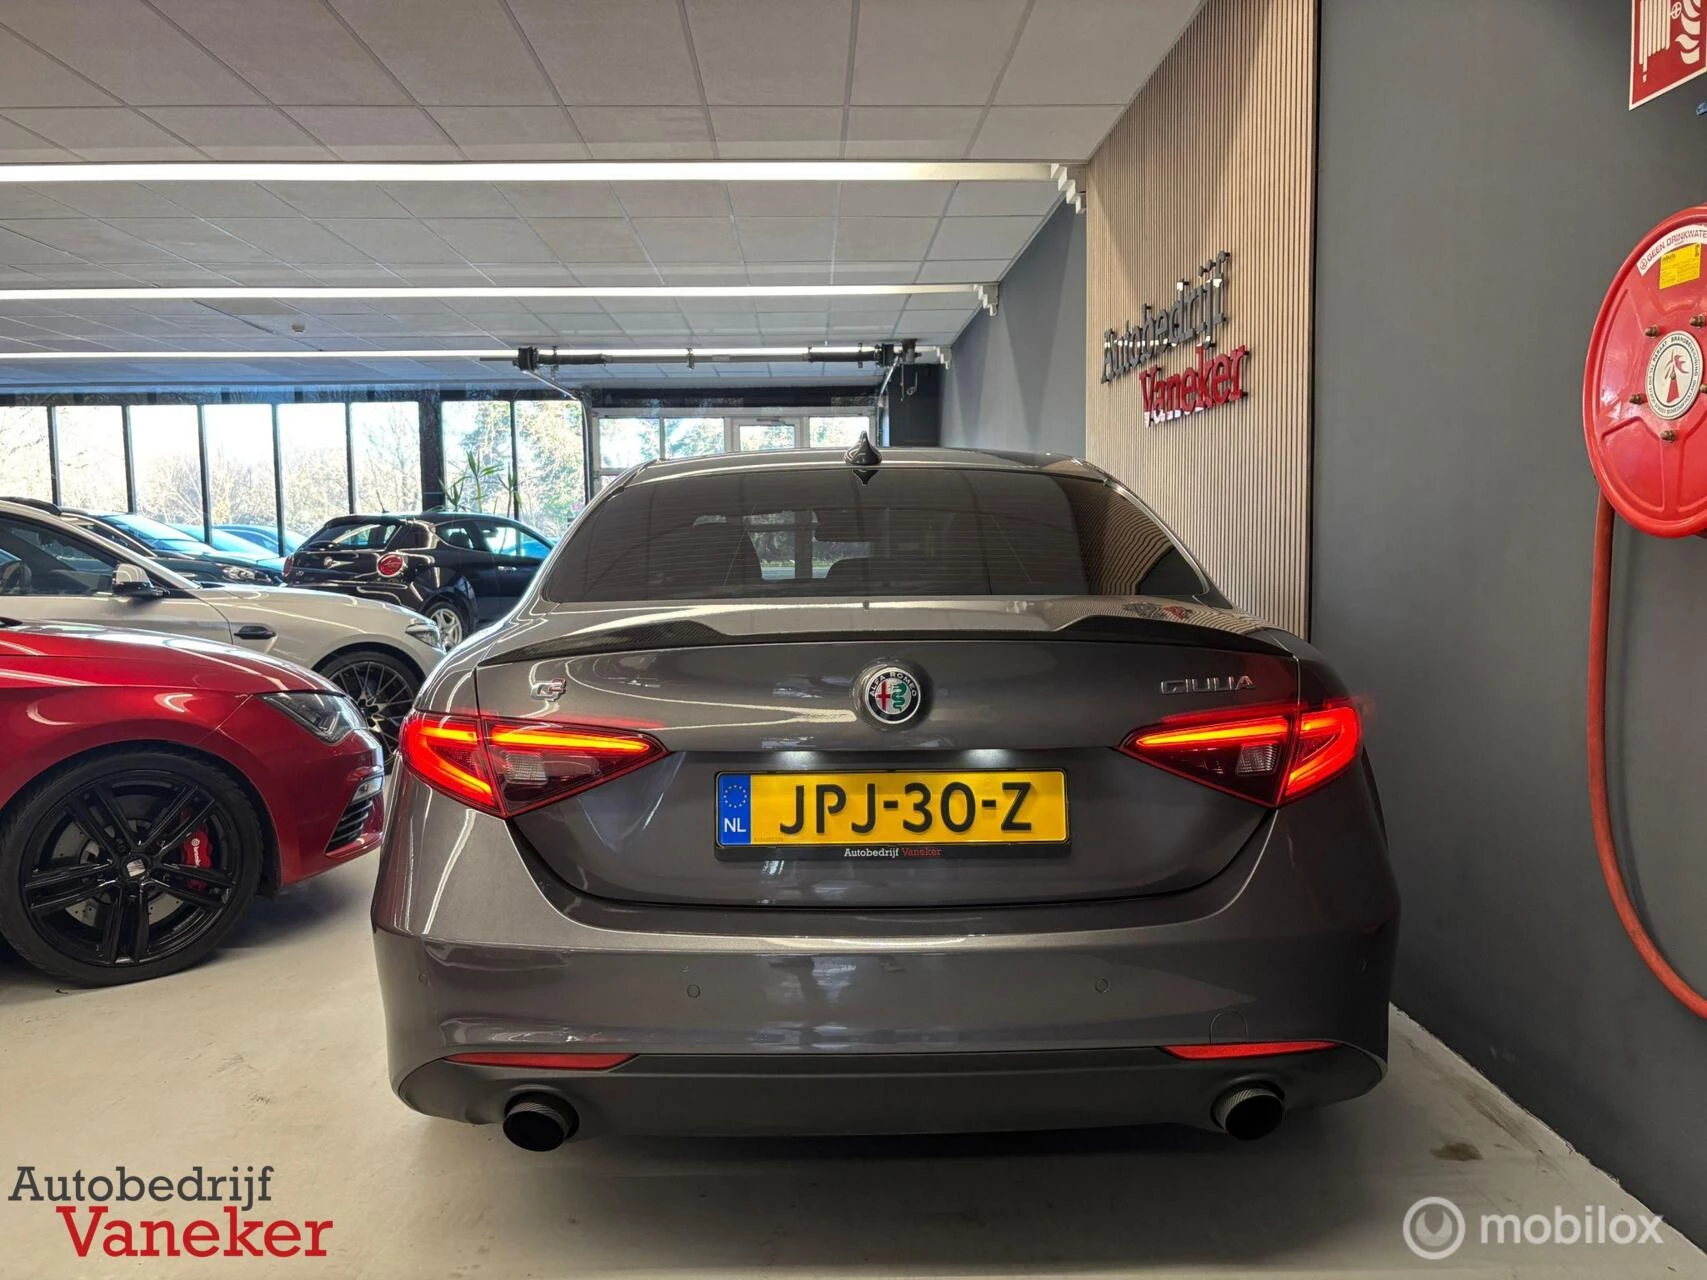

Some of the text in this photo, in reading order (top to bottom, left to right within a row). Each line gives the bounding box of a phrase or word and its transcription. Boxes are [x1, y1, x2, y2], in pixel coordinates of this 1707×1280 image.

[1647, 242, 1665, 262] GEEN
[1101, 250, 1232, 384] Autobedrijf
[1139, 344, 1249, 427] Vaneker
[869, 672, 917, 697] ALFA ROMEO
[1160, 675, 1255, 695] GIULIA
[779, 782, 1032, 835] JPJ-30-Z
[724, 818, 746, 833] NL
[844, 848, 942, 858] Autobedrijf Vaneker
